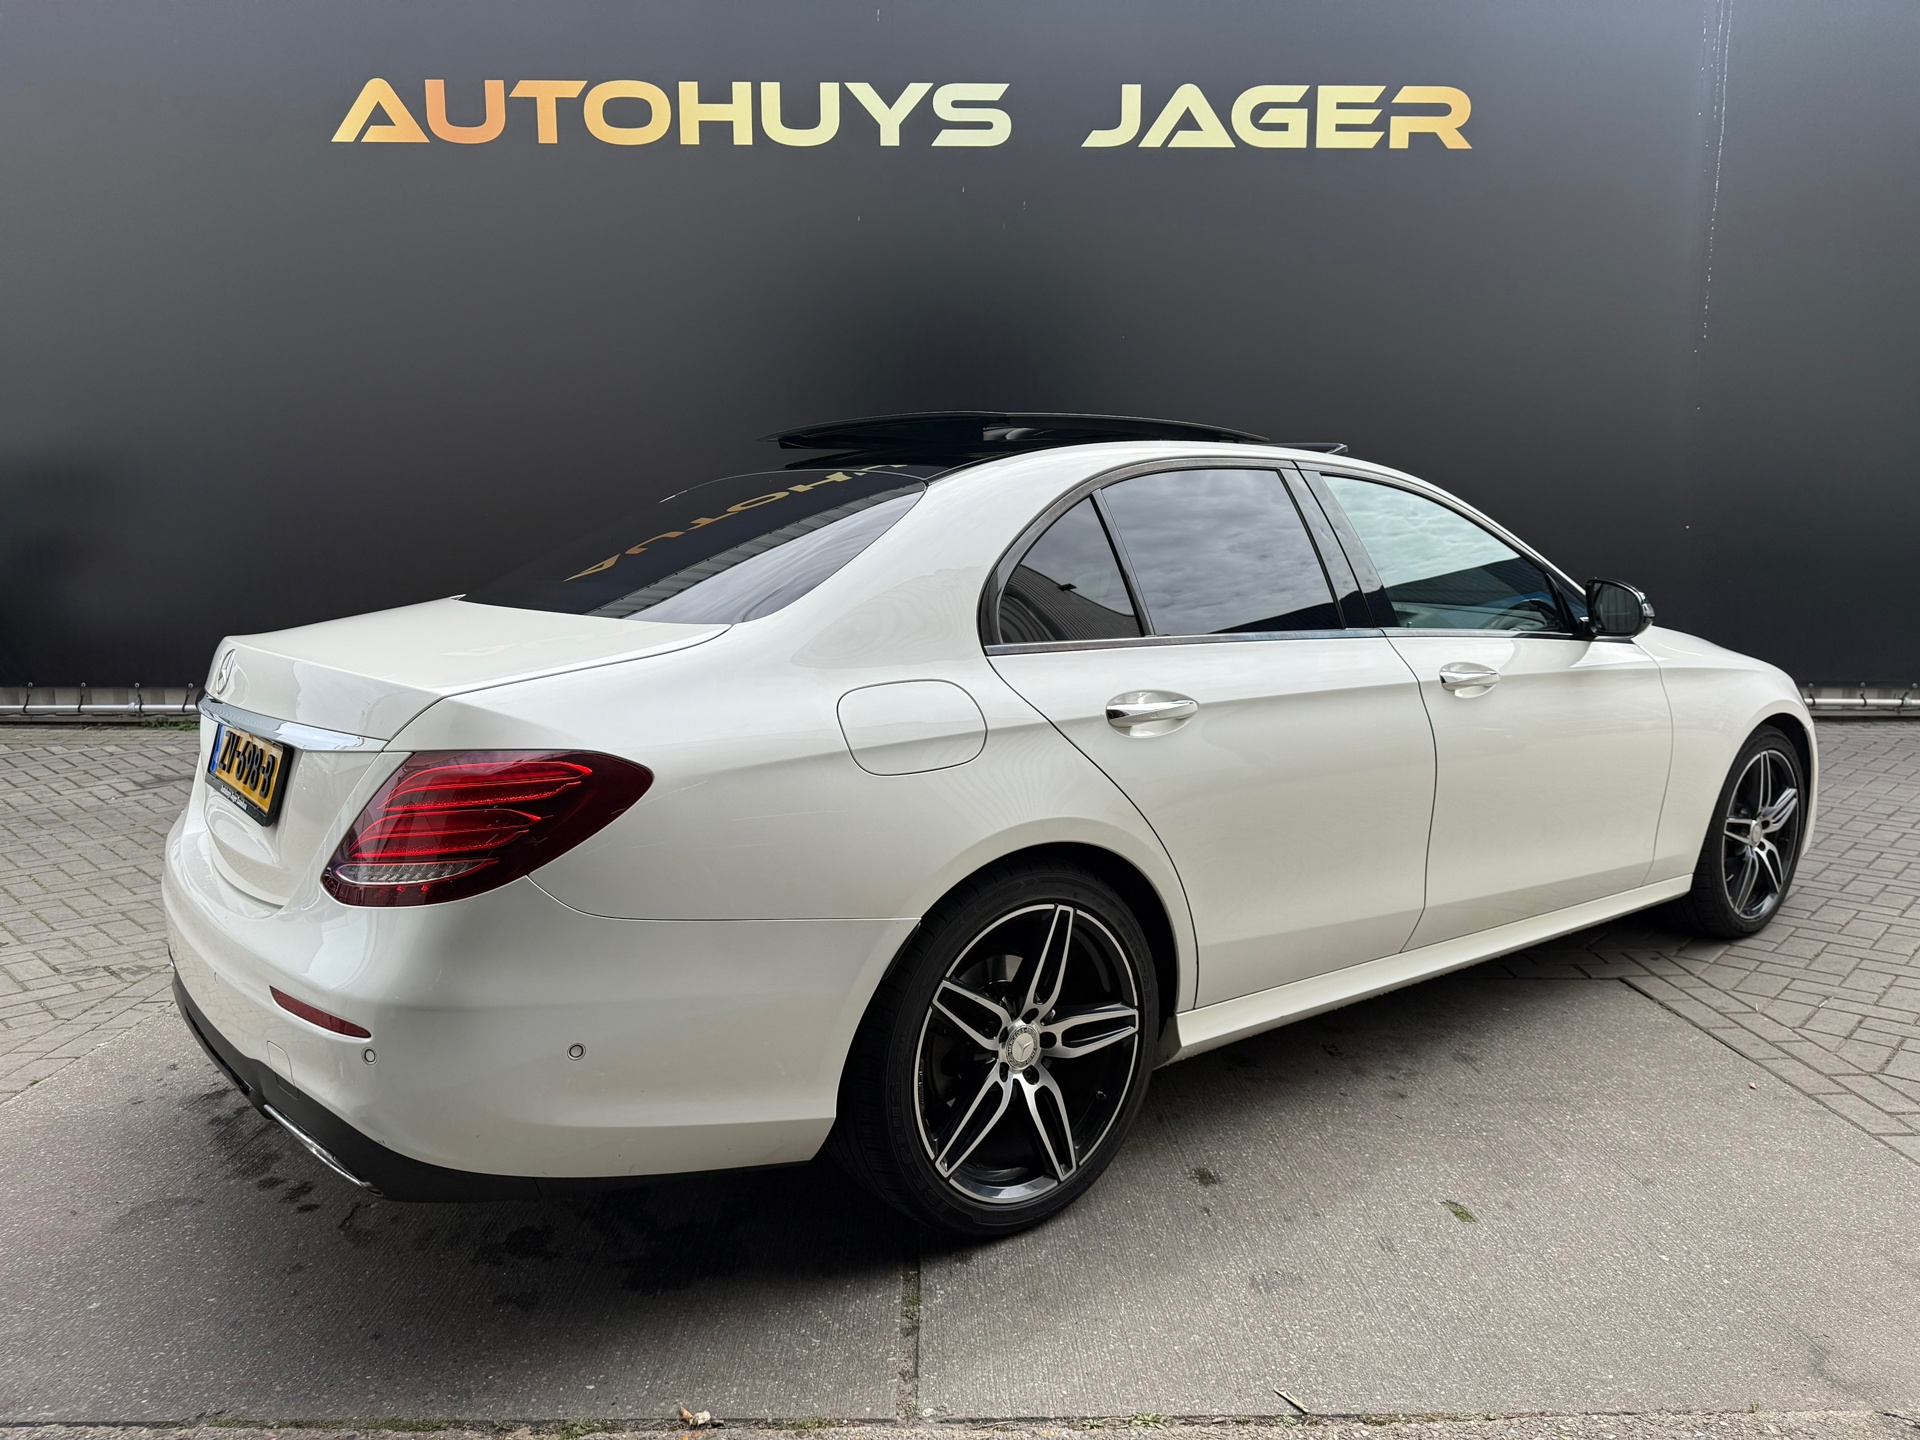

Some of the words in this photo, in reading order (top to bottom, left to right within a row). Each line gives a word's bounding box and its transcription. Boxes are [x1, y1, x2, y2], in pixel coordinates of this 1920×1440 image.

[332, 77, 1012, 147] AUTOHUYS
[1082, 83, 1472, 150] JAGER
[218, 729, 276, 799] ZV-698-B
